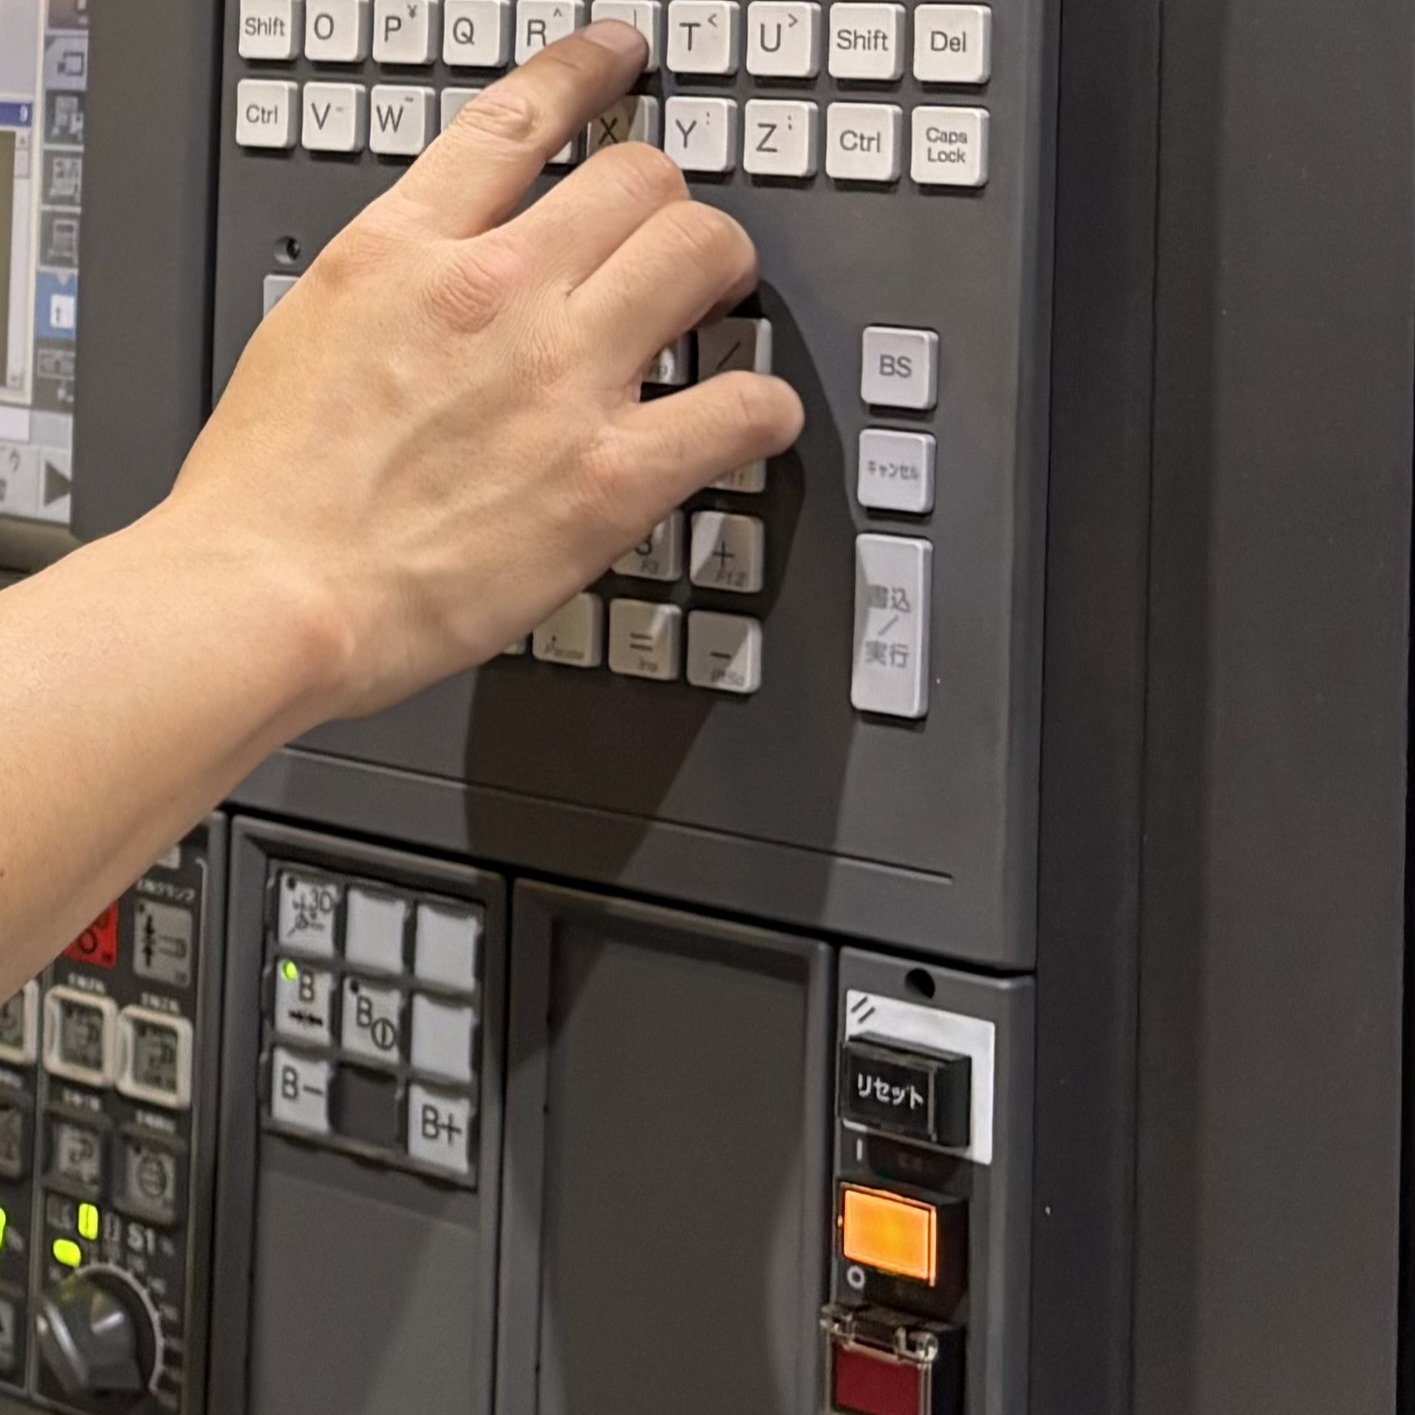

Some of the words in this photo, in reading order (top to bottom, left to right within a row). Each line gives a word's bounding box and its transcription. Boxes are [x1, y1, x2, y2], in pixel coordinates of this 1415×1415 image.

[244, 16, 286, 37] Shift
[314, 13, 335, 40] O
[384, 15, 402, 42] P
[452, 17, 475, 45] Q
[527, 19, 547, 47] R
[679, 22, 701, 52] T
[760, 23, 782, 52] U
[836, 28, 889, 52] Shift
[930, 30, 967, 53] Del
[245, 104, 278, 124] Ctrl
[311, 102, 331, 130] V
[376, 104, 404, 133] W
[598, 116, 619, 144] X
[675, 119, 697, 149] Y
[755, 122, 778, 153] Z
[839, 129, 881, 153] Ctrl
[925, 126, 968, 146] Caps
[927, 147, 966, 164] Lock
[879, 354, 912, 378] BS
[867, 460, 920, 480] キャンセル
[868, 584, 911, 613] 書込
[865, 640, 910, 669] 実行
[298, 969, 315, 1003] B
[356, 996, 372, 1029] B
[857, 1073, 924, 1111] リセット
